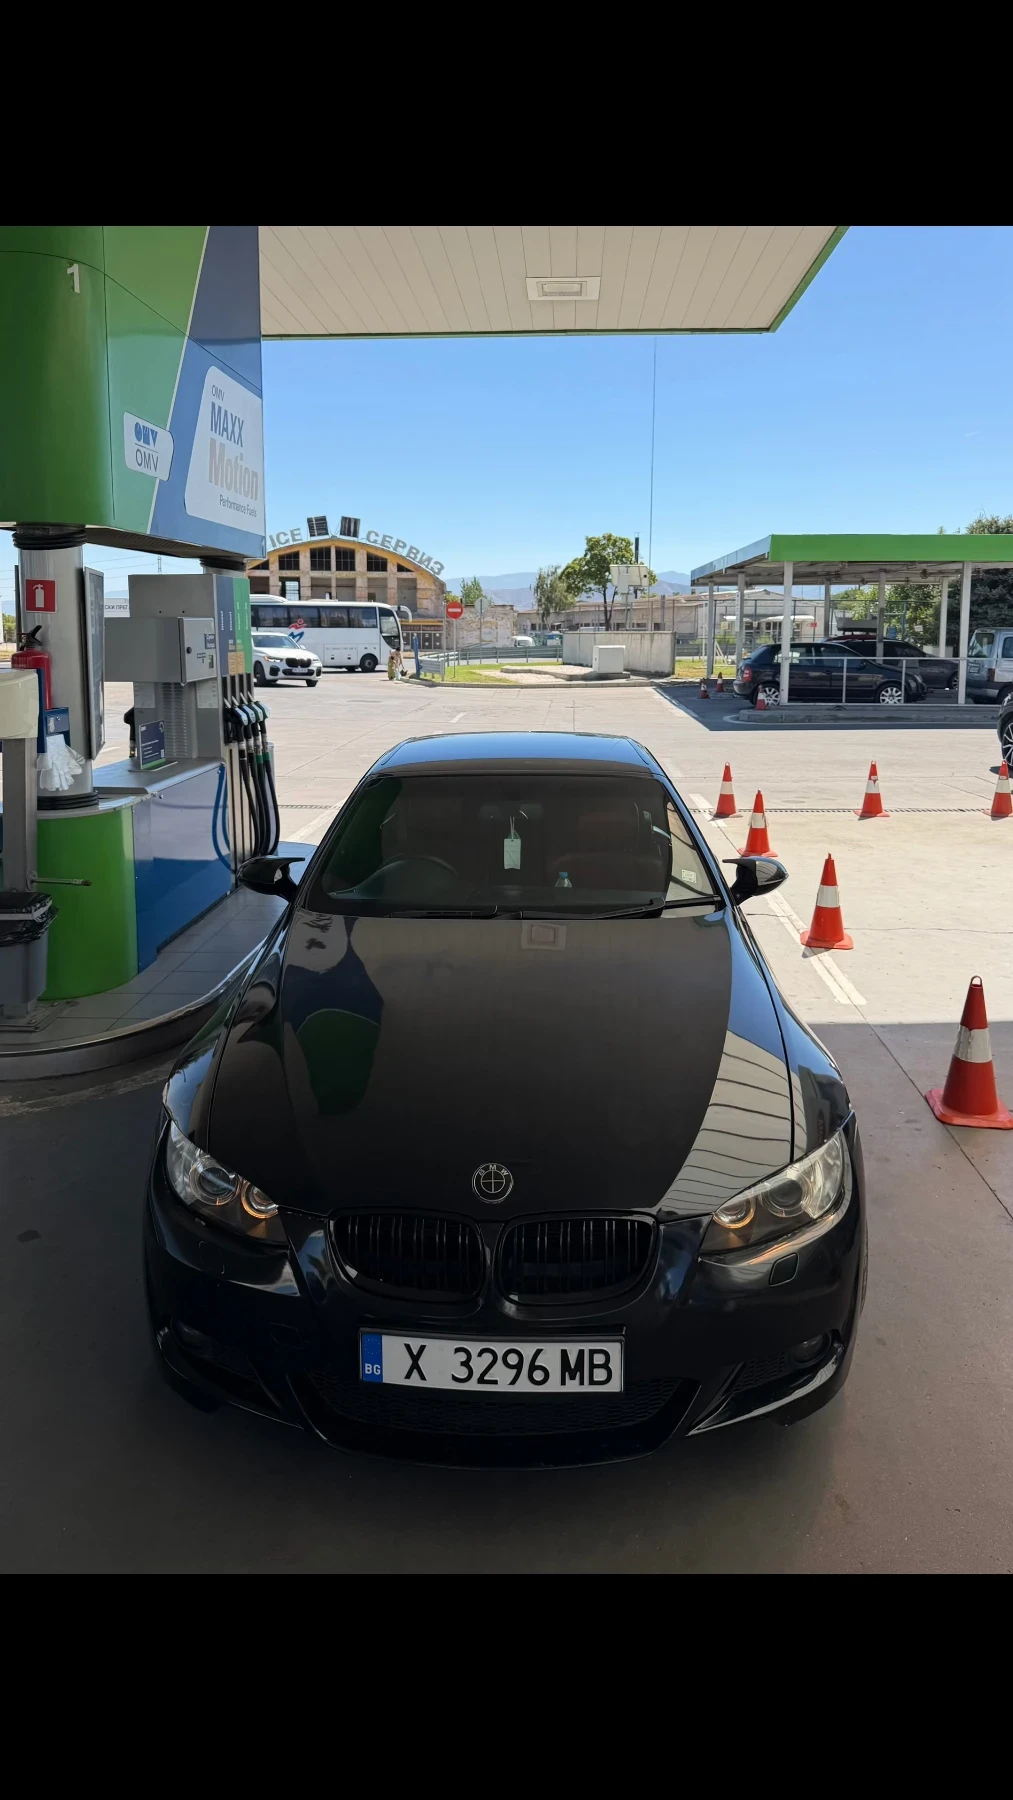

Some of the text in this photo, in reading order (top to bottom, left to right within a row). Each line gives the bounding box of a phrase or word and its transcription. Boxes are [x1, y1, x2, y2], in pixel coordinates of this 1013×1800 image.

[67, 263, 80, 294] 1
[211, 384, 225, 402] OMV
[210, 401, 244, 448] MAXX
[135, 448, 159, 472] OMV
[208, 437, 259, 501] Motion
[219, 494, 257, 517] Performance Fuels
[268, 527, 303, 549] ICE
[366, 530, 445, 577] СЕРВИЗ
[364, 1363, 381, 1376] BG
[403, 1343, 613, 1386] X 3296 MB
